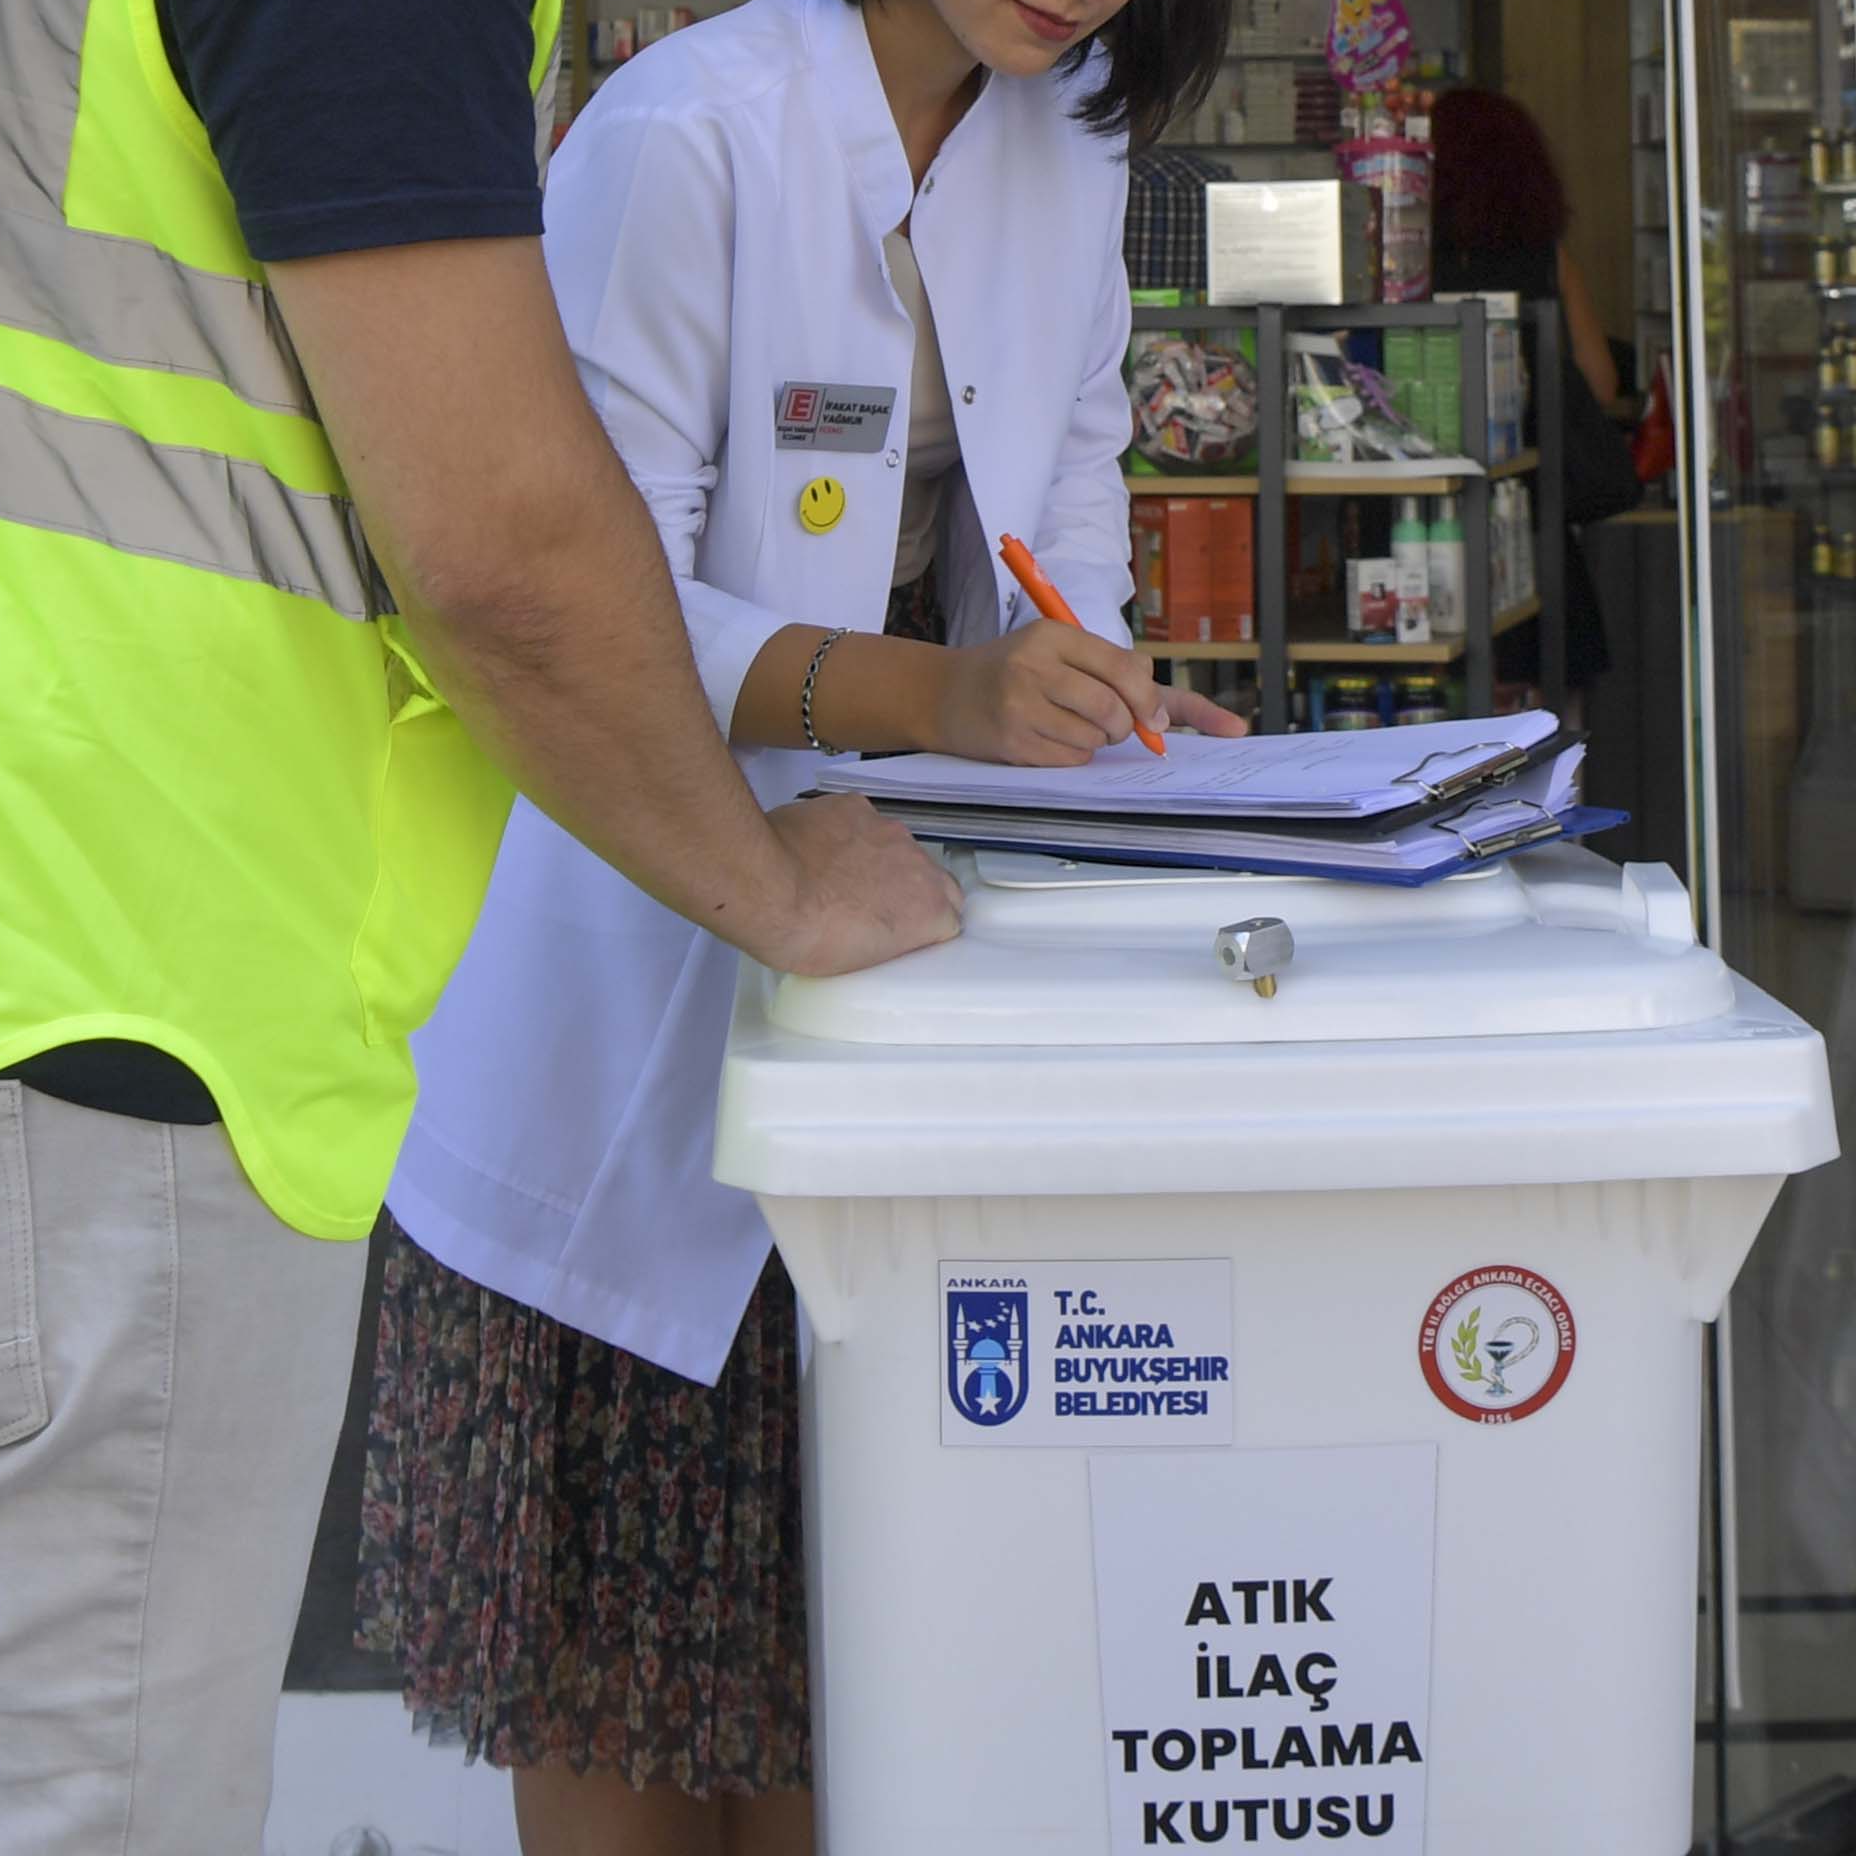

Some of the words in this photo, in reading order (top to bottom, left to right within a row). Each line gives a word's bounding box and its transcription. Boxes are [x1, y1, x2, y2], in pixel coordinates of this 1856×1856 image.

[946, 1277, 1029, 1289] ANKARA
[1054, 1289, 1106, 1316] T.C.
[1055, 1323, 1175, 1350] ANKARA
[1423, 1327, 1435, 1352] TEB
[1473, 1271, 1523, 1287] ANKARA
[1524, 1277, 1561, 1312] ECZACI
[1555, 1311, 1572, 1351] ODASI
[1184, 1577, 1336, 1626] ATIK
[1196, 1641, 1339, 1713] İLAÇ
[1111, 1720, 1424, 1775] TOPLAMA
[1142, 1792, 1396, 1847] KUTUSU
